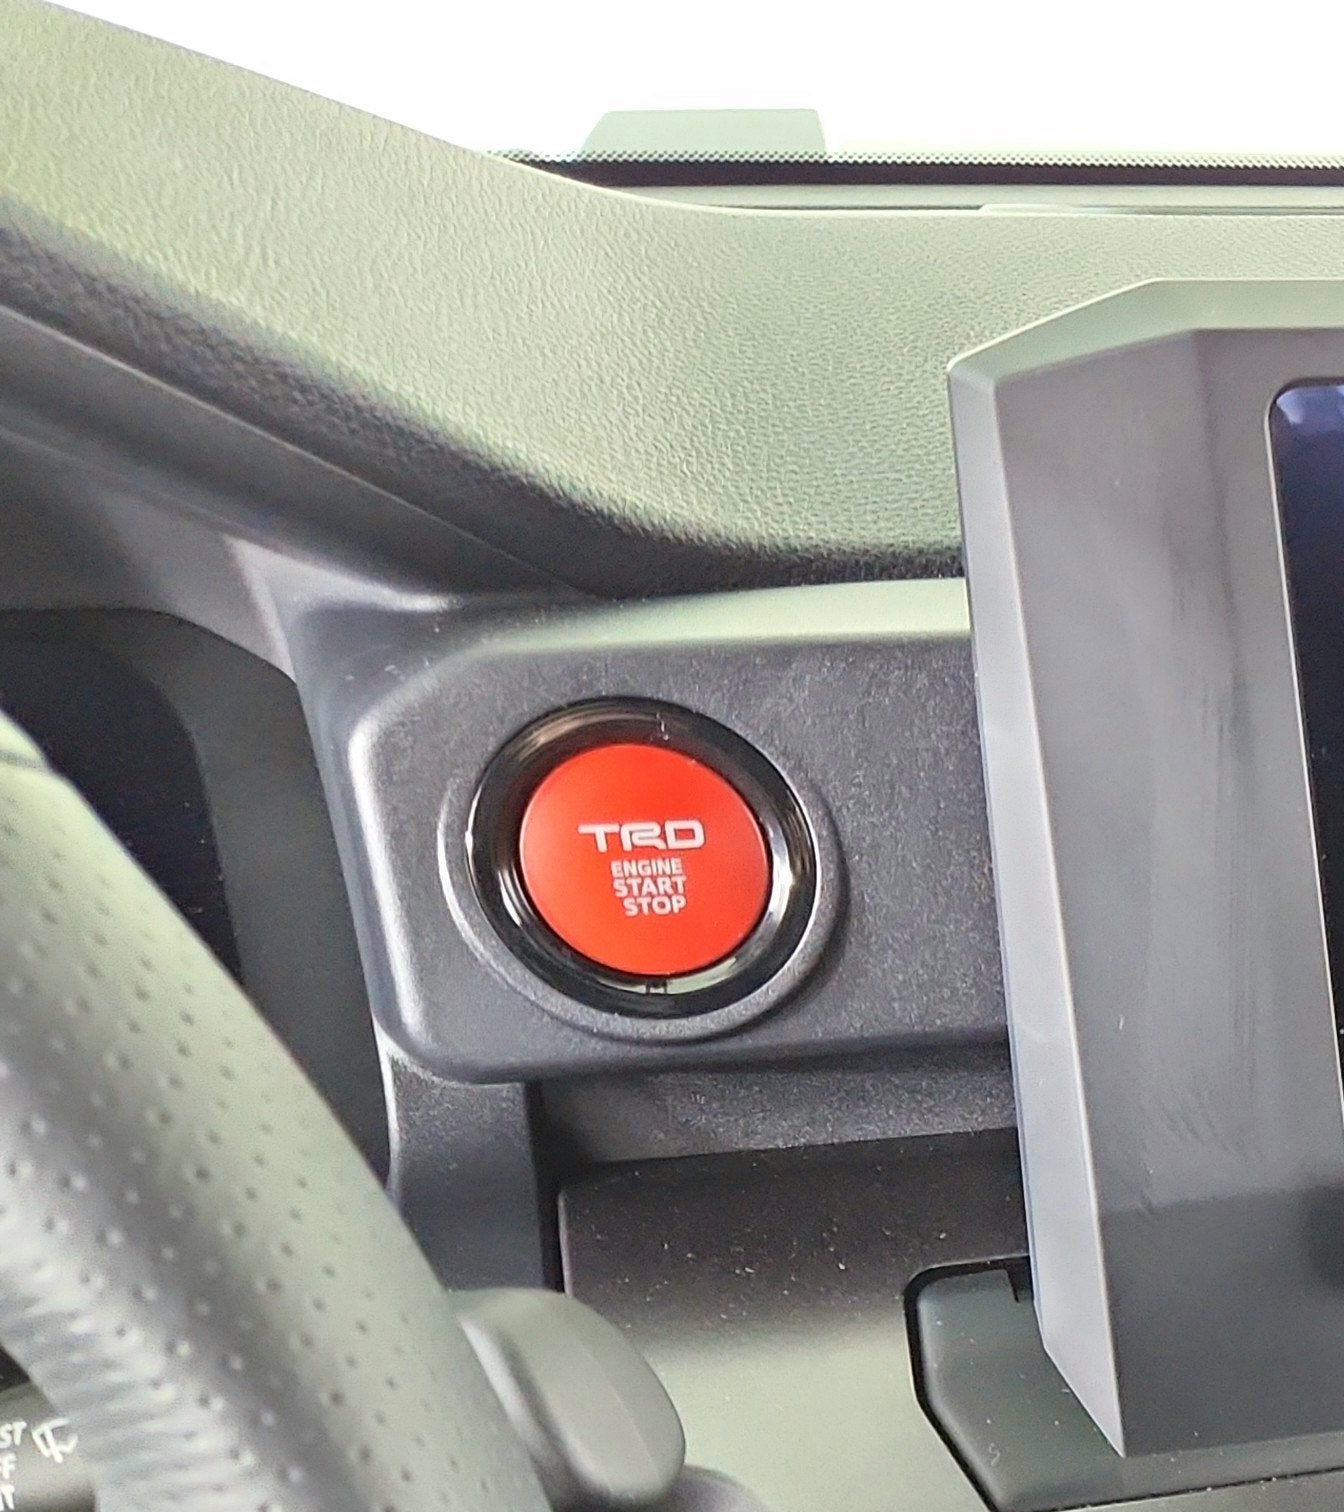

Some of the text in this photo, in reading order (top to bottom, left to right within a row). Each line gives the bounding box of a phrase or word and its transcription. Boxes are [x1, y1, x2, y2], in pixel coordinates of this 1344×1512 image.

[577, 818, 706, 852] TRD
[610, 857, 683, 877] ENGINE
[612, 876, 686, 898] START
[622, 895, 686, 917] STOP
